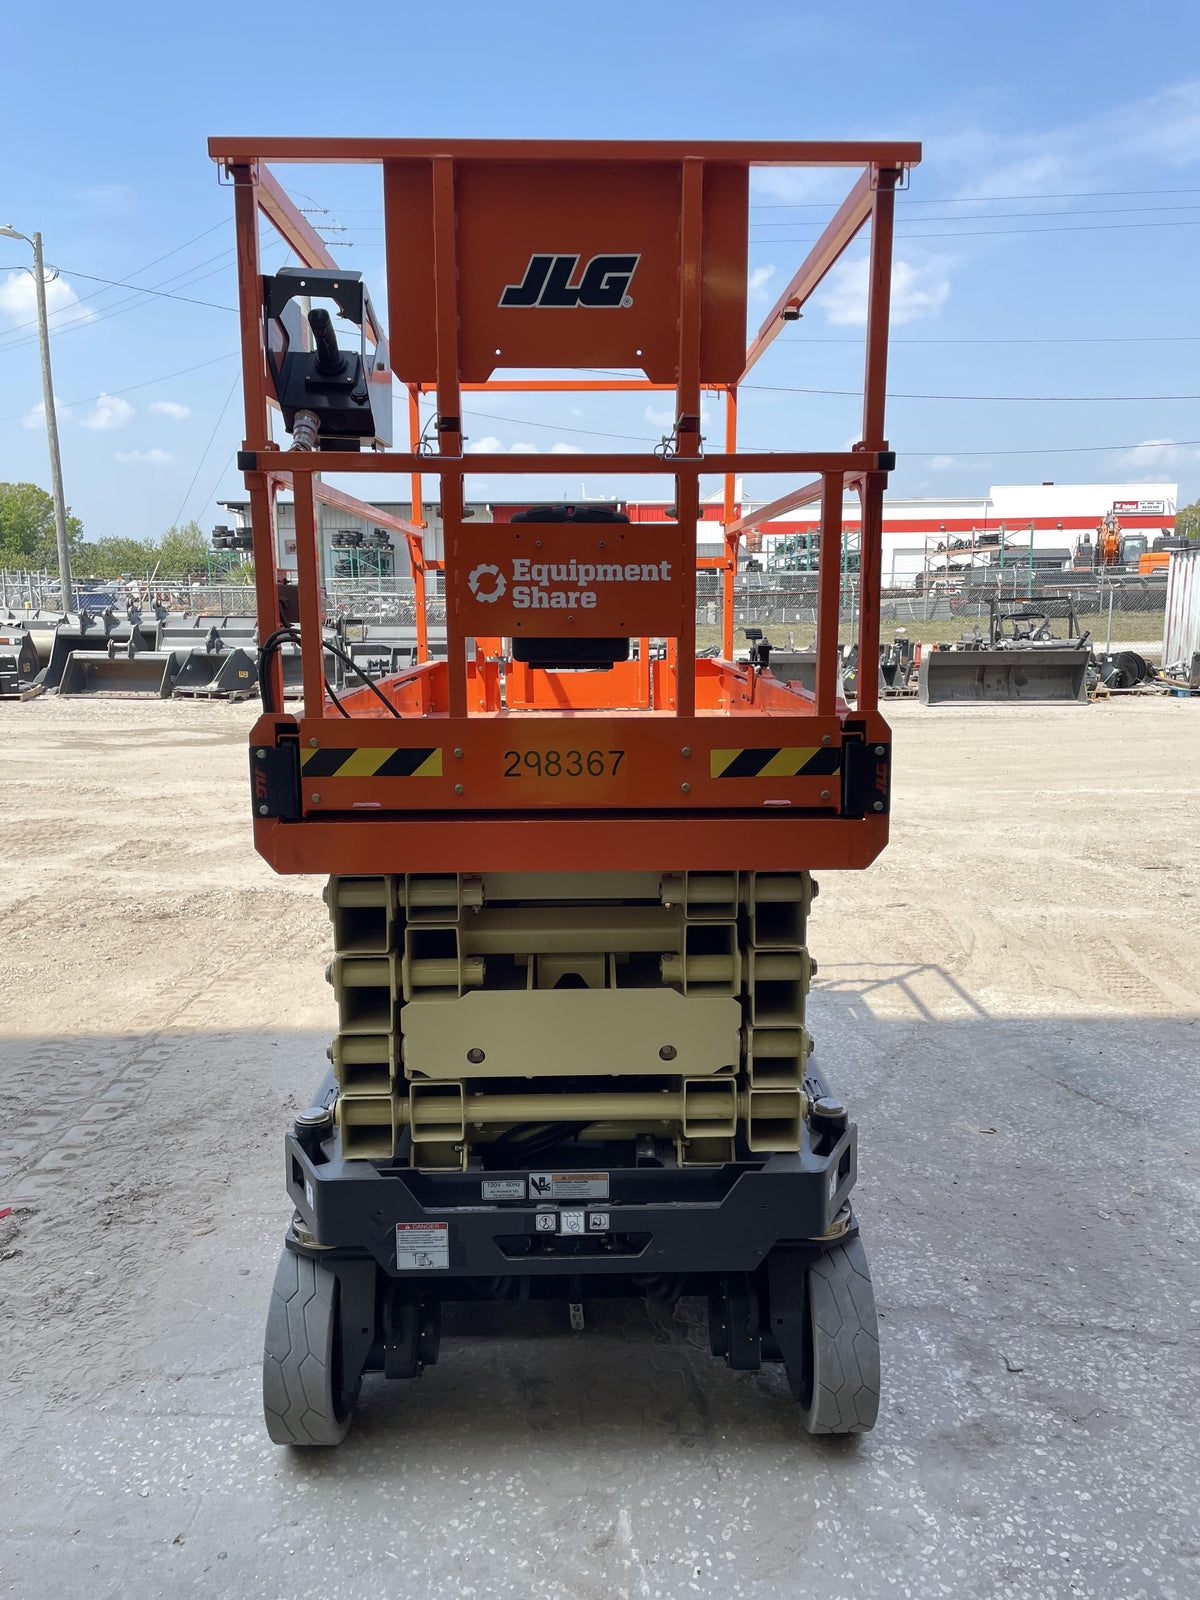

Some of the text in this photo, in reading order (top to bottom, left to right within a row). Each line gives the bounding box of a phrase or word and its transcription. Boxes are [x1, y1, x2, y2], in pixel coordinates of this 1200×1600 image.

[497, 253, 642, 309] JLG
[512, 558, 672, 586] Equipment
[512, 586, 597, 609] Share
[503, 750, 626, 778] 298367
